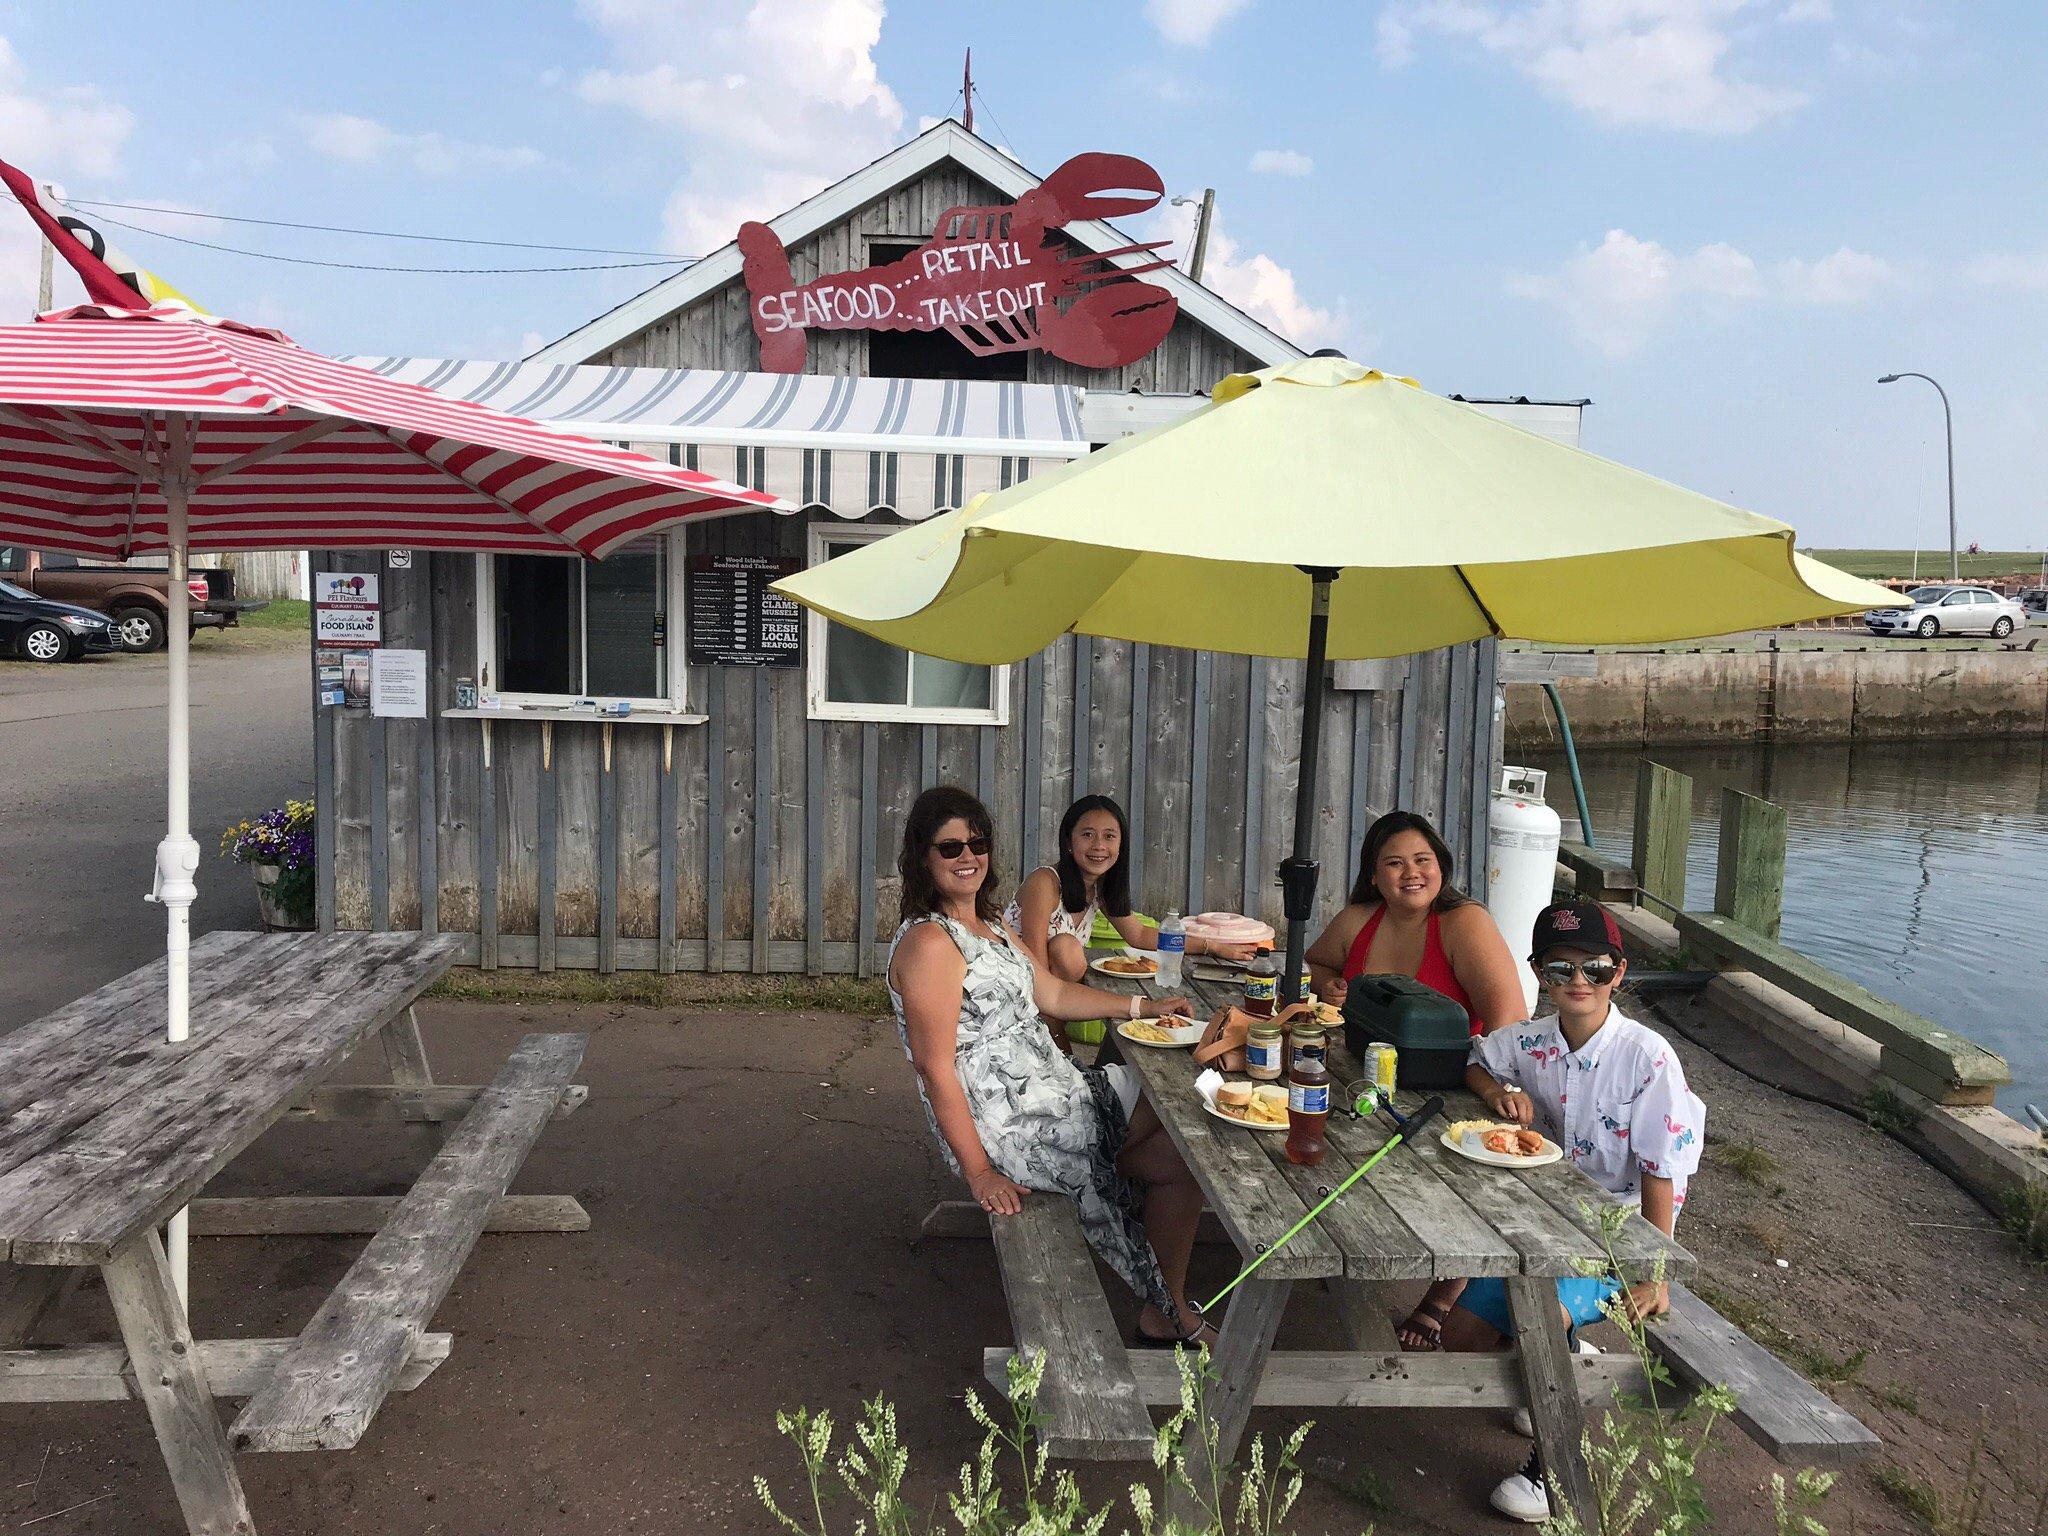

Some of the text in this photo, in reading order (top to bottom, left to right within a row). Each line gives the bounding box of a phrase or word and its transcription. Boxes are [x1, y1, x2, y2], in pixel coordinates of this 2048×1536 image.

[759, 283, 895, 333] SEAFOOD
[761, 601, 798, 609] CLAMS
[761, 609, 798, 617] MUSSELS
[321, 622, 374, 631] FOOD ISLAND
[761, 624, 798, 633] FRESH
[761, 632, 798, 642] LOCAL
[761, 641, 799, 649] SEAFOOD
